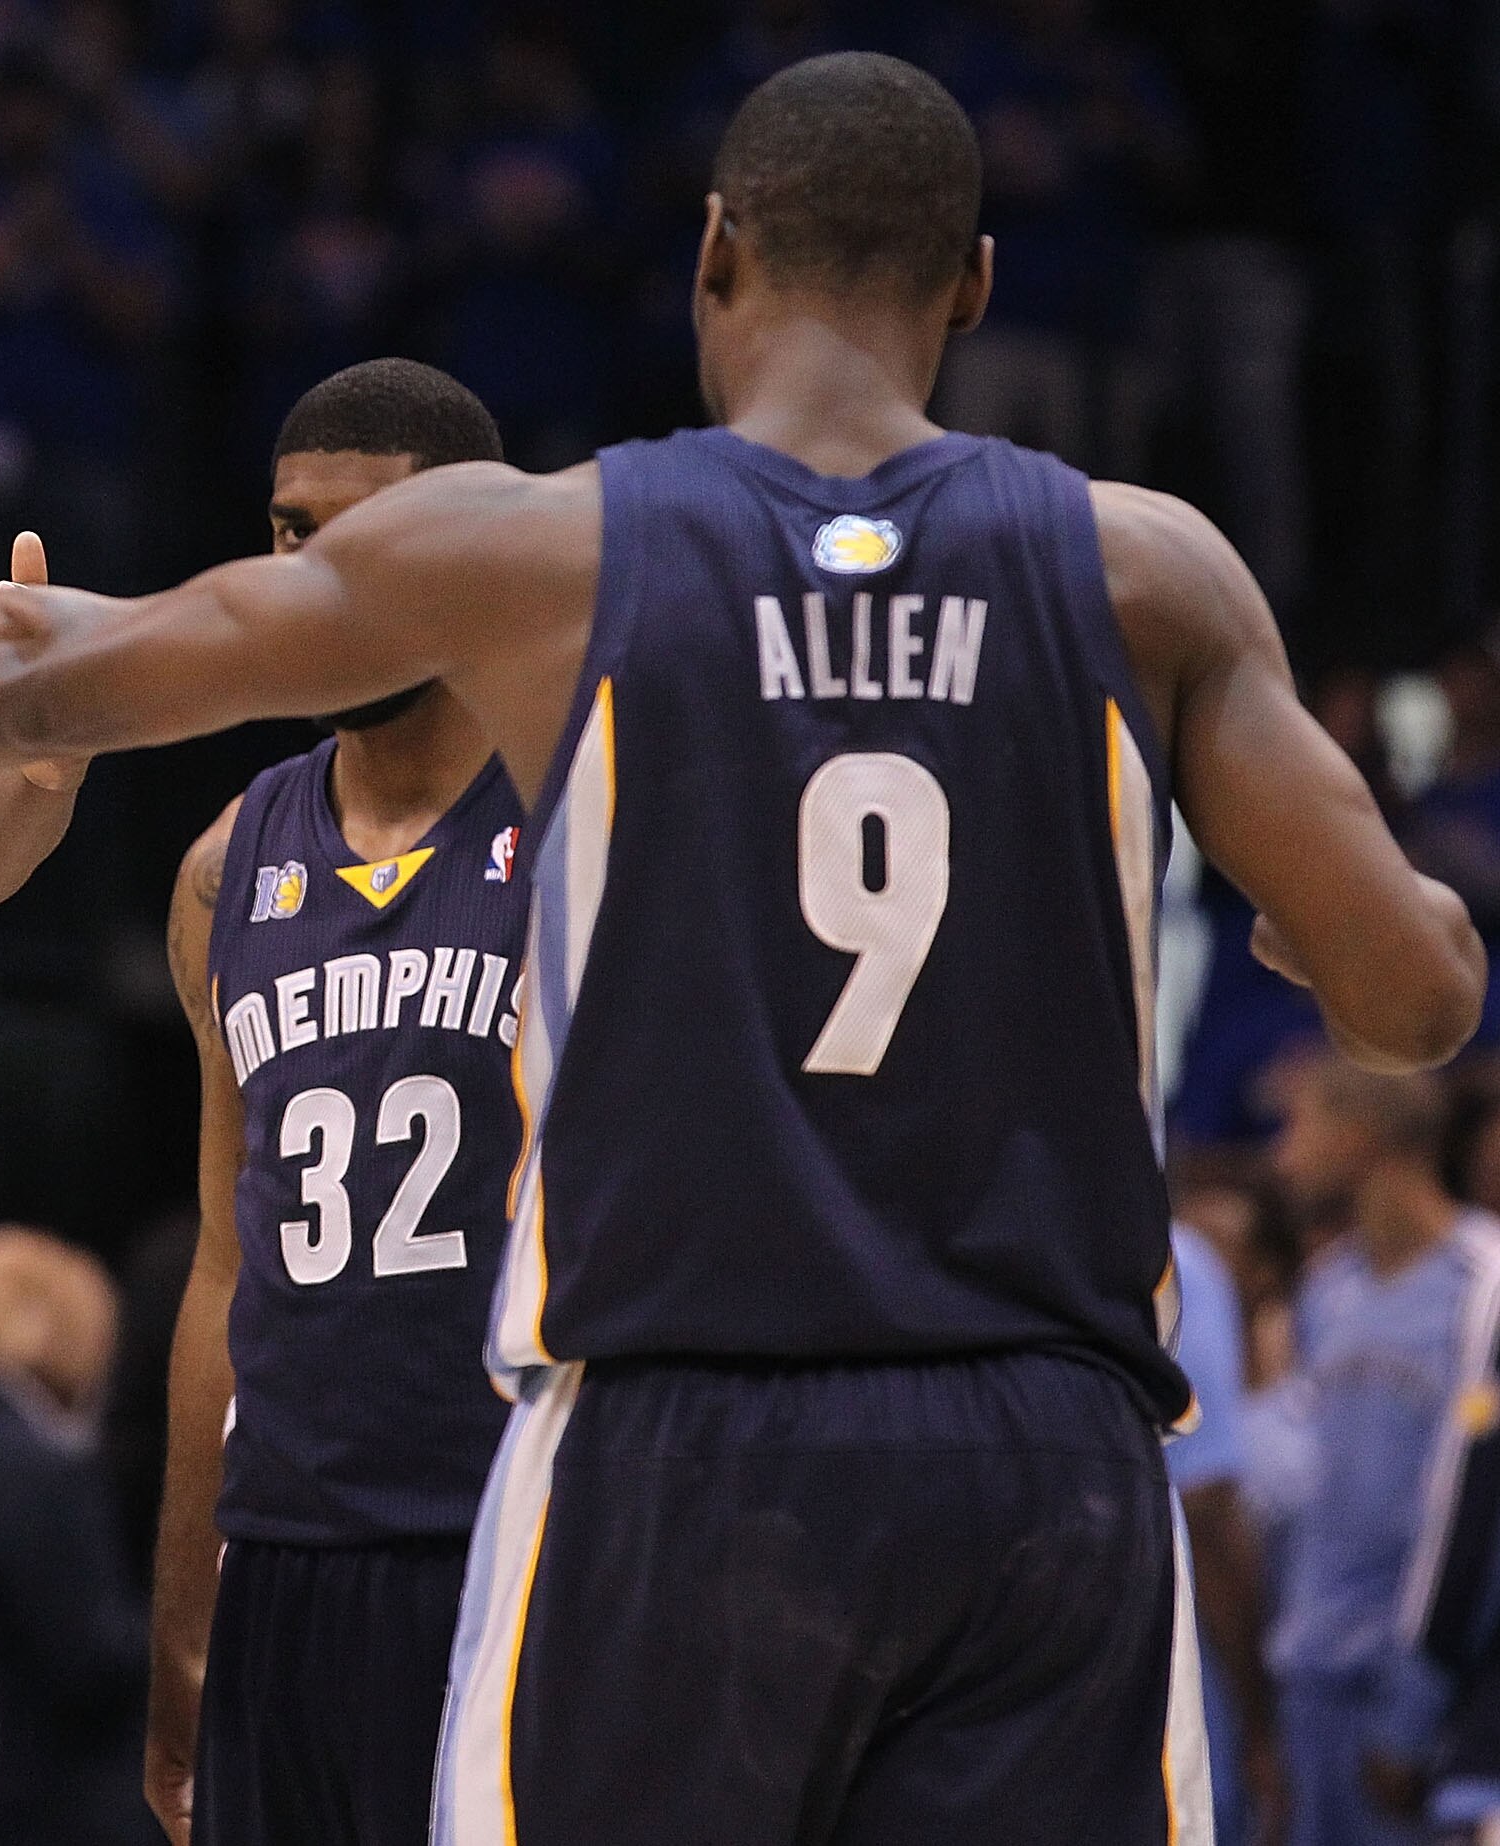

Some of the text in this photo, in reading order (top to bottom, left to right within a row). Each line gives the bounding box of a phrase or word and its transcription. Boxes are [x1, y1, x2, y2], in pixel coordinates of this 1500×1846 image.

[755, 591, 988, 706] ALLEN
[798, 752, 950, 1075] 9
[279, 1074, 468, 1285] 32
